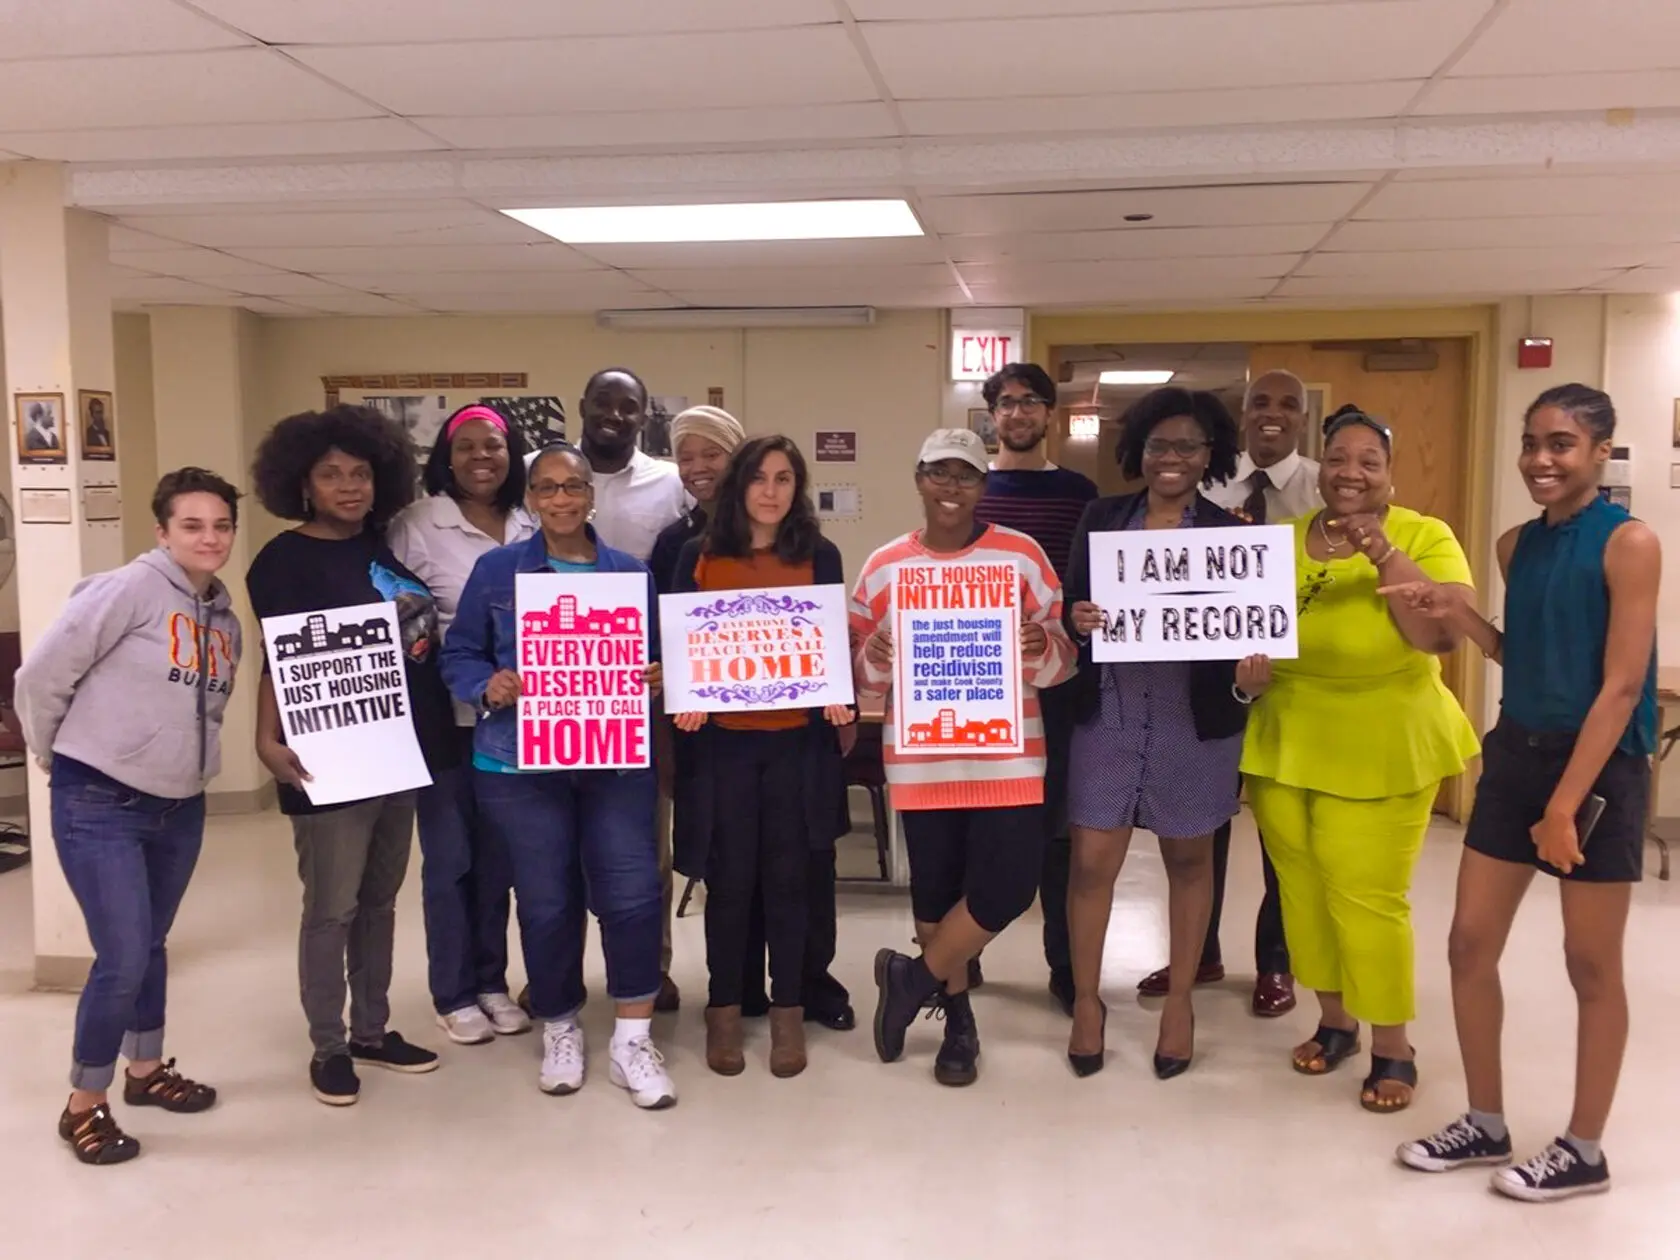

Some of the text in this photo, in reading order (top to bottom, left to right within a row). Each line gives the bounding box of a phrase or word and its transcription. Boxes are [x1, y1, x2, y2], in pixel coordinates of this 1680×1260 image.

[962, 337, 1011, 372] EXIT
[897, 565, 1014, 585] JUST HOUSING
[1117, 544, 1269, 583] I AM NOT
[897, 583, 1015, 610] INITIATIVE
[688, 625, 824, 644] DESERVES A
[721, 619, 786, 629] EVERYONE
[912, 618, 1002, 632] the just housing
[1101, 604, 1289, 643] MY RECORD
[687, 640, 826, 657] PLACE TO CALL
[912, 631, 1002, 643] amendment will
[522, 639, 644, 666] EVERYONE
[913, 643, 1002, 660] help reduce
[278, 650, 398, 684] I SUPPORT THE
[689, 652, 825, 683] HOME
[913, 659, 1003, 677] recidivism
[284, 669, 402, 706] JUST HOUSING
[522, 669, 645, 697] DESERVES
[954, 677, 973, 686] Cook
[975, 677, 1003, 687] County
[914, 687, 1004, 701] a safer place
[287, 692, 406, 737] INITIATIVE
[523, 699, 644, 716] A PLACE TO CALL
[523, 718, 646, 765] HOME
